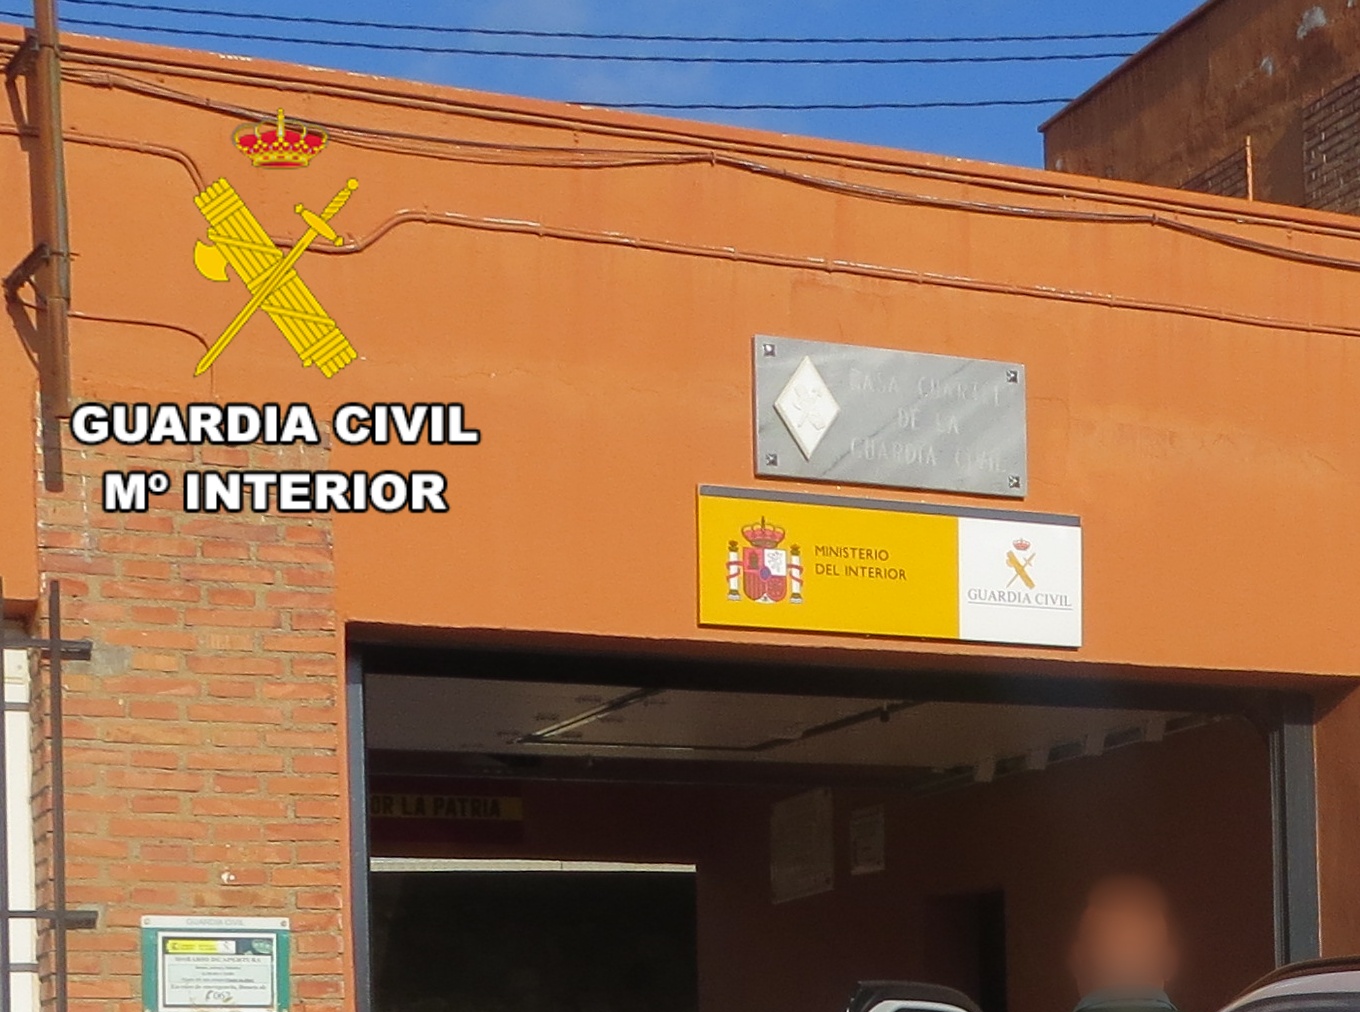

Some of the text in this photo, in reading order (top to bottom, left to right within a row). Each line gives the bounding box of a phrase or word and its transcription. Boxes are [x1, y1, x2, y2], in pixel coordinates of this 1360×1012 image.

[814, 545, 889, 561] MINISTERIO
[815, 563, 907, 580] DEL INTERIOR
[967, 588, 1073, 607] GUARDIA CIVIL
[401, 796, 425, 815] LA
[433, 797, 501, 818] PATRIA
